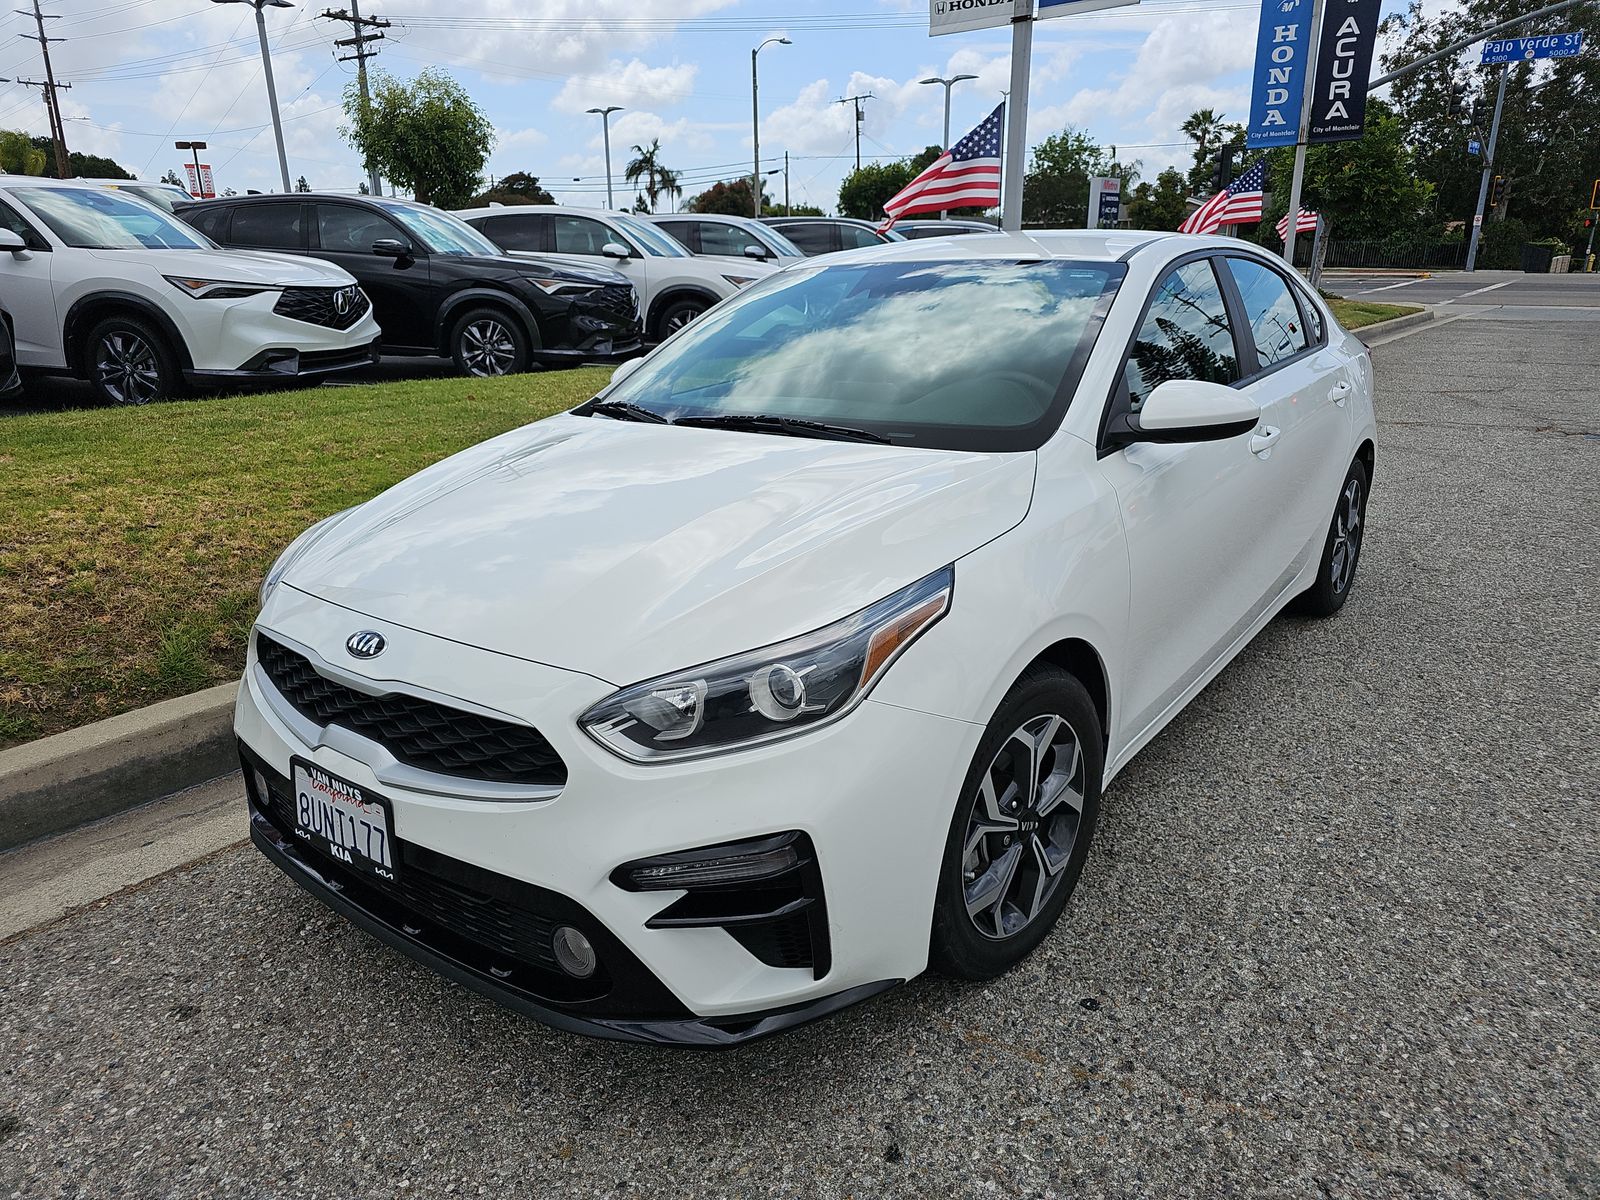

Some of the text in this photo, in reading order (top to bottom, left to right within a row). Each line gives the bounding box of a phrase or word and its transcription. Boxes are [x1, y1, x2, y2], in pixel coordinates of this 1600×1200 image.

[1484, 33, 1580, 54] Palo Verde St
[1549, 49, 1568, 57] 5000
[1261, 24, 1299, 126] HONDA
[1325, 16, 1360, 120] ACURA
[1269, 129, 1296, 137] Montclair
[1312, 126, 1324, 134] City
[1332, 124, 1360, 132] Montclair
[310, 767, 363, 801] VAN NUYS
[299, 792, 385, 866] 8UNT177
[330, 842, 354, 865] KIA
